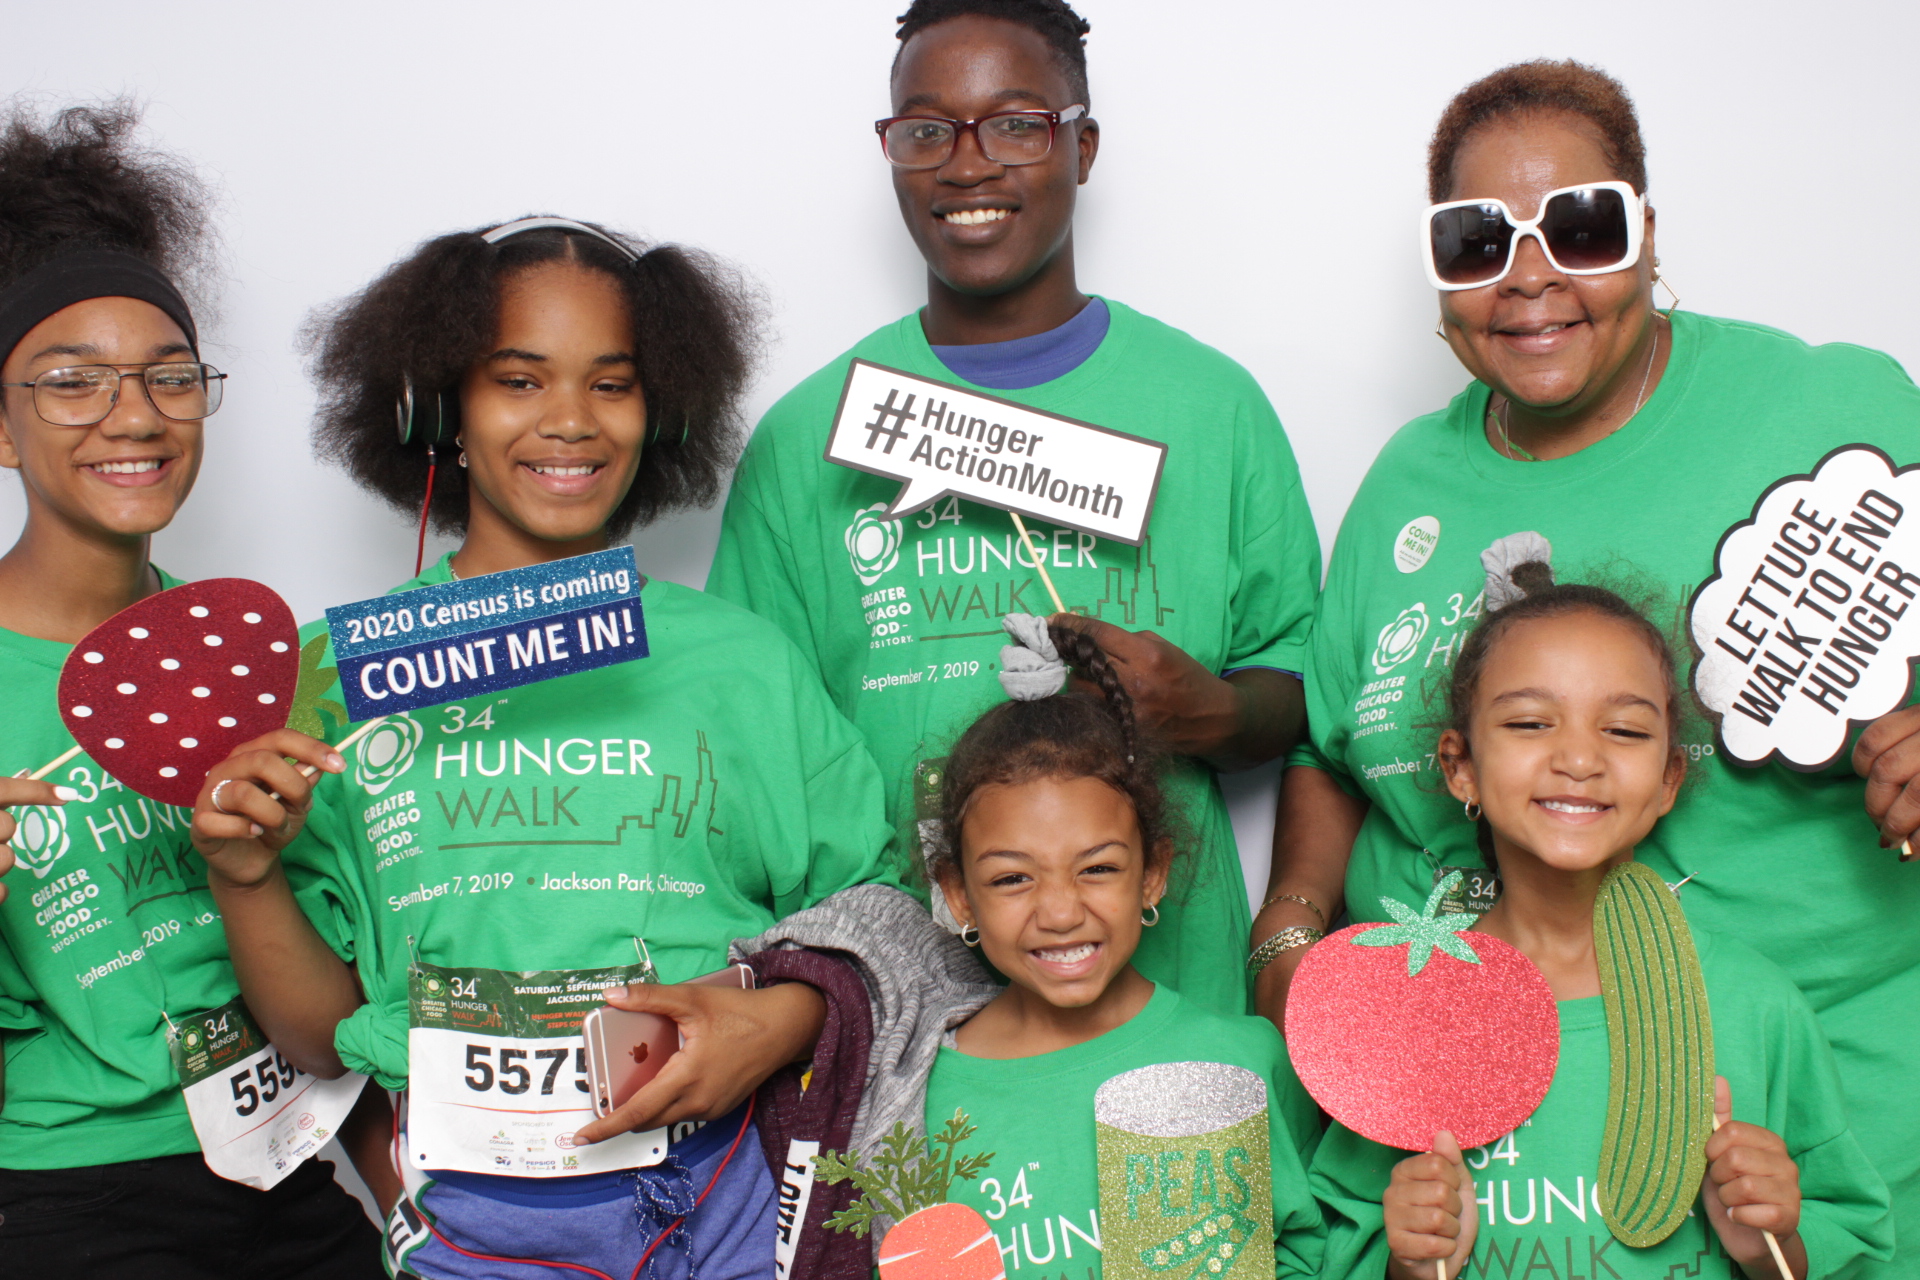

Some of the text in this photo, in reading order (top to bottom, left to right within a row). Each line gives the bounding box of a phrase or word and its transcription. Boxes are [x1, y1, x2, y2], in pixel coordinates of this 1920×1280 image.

[909, 433, 1124, 519] ActionMonth
[916, 497, 963, 529] 34
[1402, 537, 1418, 551] ME
[1408, 525, 1437, 546] COUNT
[916, 530, 1098, 577] HUNGER
[1714, 498, 1838, 665] LETTUCE
[346, 568, 631, 644] 2020 Census is coming
[865, 602, 912, 625] CAGO
[918, 578, 1033, 623] WALK
[1441, 588, 1485, 626] 34
[1732, 488, 1904, 727] WALK TO END
[360, 608, 636, 701] COUNT ME IN!
[1800, 560, 1920, 716] HUNGER
[861, 661, 980, 692] September 7, 2019
[1361, 675, 1406, 697] GREATER
[1354, 690, 1403, 713] CHICAGO
[434, 738, 654, 779] HUNGER
[1361, 756, 1421, 783] September
[68, 766, 124, 803] 34
[363, 789, 417, 824] GREATER
[434, 786, 581, 831] WALK
[366, 807, 421, 842] CHICAGO
[31, 868, 91, 908] GREATER
[452, 876, 463, 897] 7,
[469, 872, 515, 895] 2019
[540, 872, 612, 891] Jackson
[617, 873, 655, 896] Park,
[656, 874, 706, 898] Chicago
[1469, 876, 1496, 900] 34
[35, 883, 100, 927] CHICAGO
[142, 919, 181, 948] 2019
[513, 985, 564, 995] SATURDAY,
[566, 981, 617, 993] SEPTEMBER
[546, 993, 590, 1005] JACKSON
[451, 1000, 489, 1013] HUNGER
[452, 1011, 475, 1021] WALK
[531, 1010, 588, 1020] HUNGER WALK
[209, 1030, 240, 1051] HUNGER
[211, 1046, 233, 1060] WALK
[230, 1050, 306, 1117] 559
[1124, 1146, 1250, 1220] PEAS
[993, 1209, 1102, 1270] HUN
[1471, 1235, 1622, 1280] WALK
